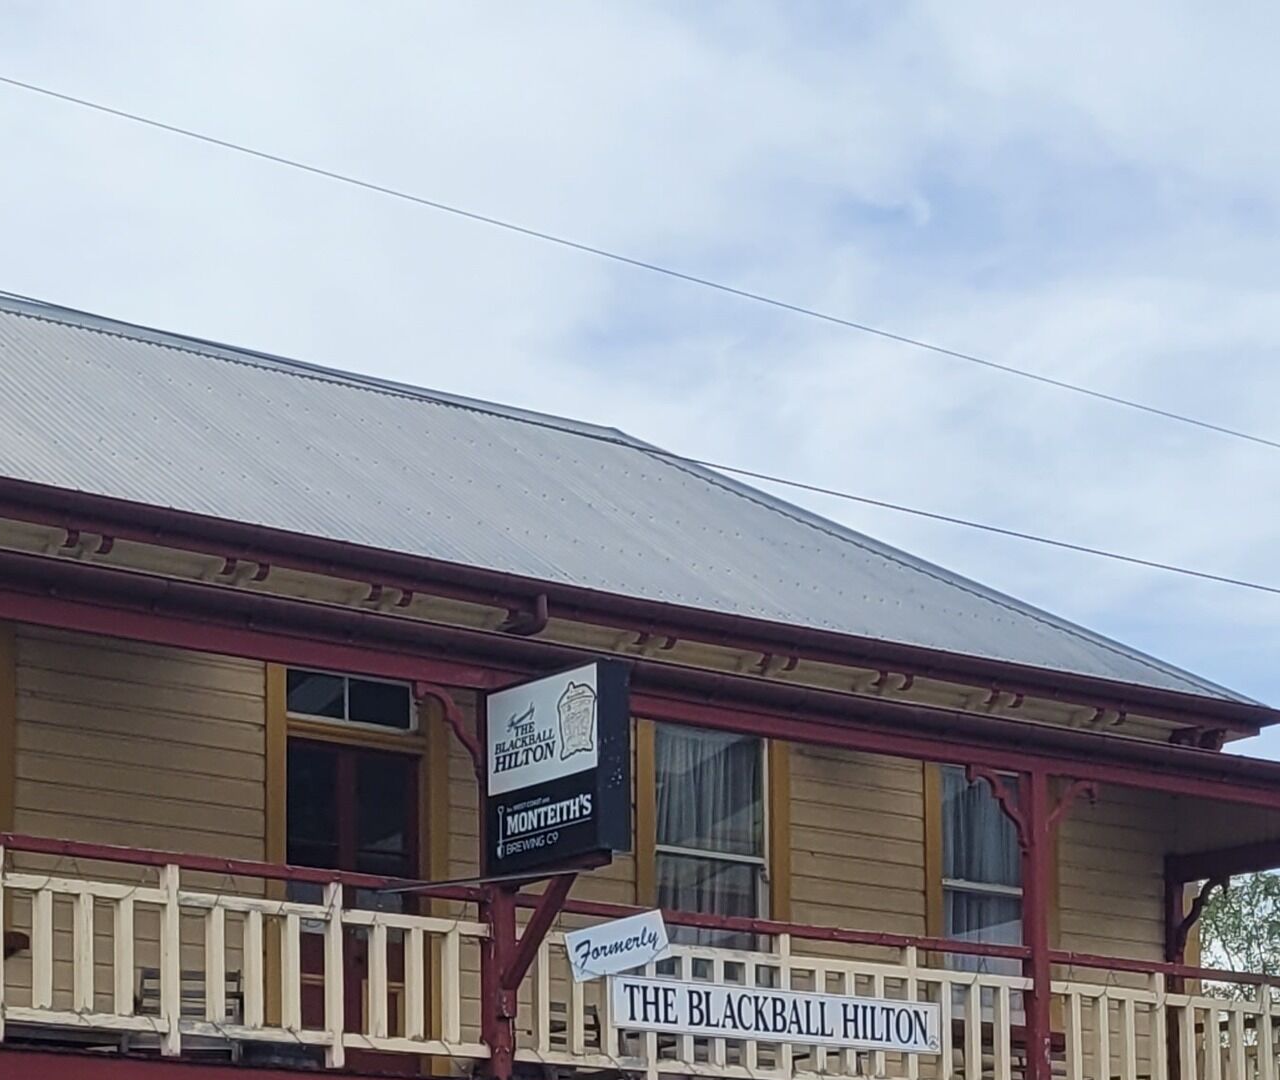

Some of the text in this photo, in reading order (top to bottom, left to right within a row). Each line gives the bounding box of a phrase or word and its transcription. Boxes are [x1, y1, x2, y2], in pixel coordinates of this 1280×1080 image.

[495, 728, 555, 755] BLACKBALL
[514, 721, 535, 737] THE
[493, 740, 556, 774] HILTON
[506, 793, 592, 836] MONTEITH'S
[506, 835, 545, 855] BREWING
[574, 925, 660, 967] Formerly
[623, 983, 929, 1046] THE BLACKBALL HILTON
